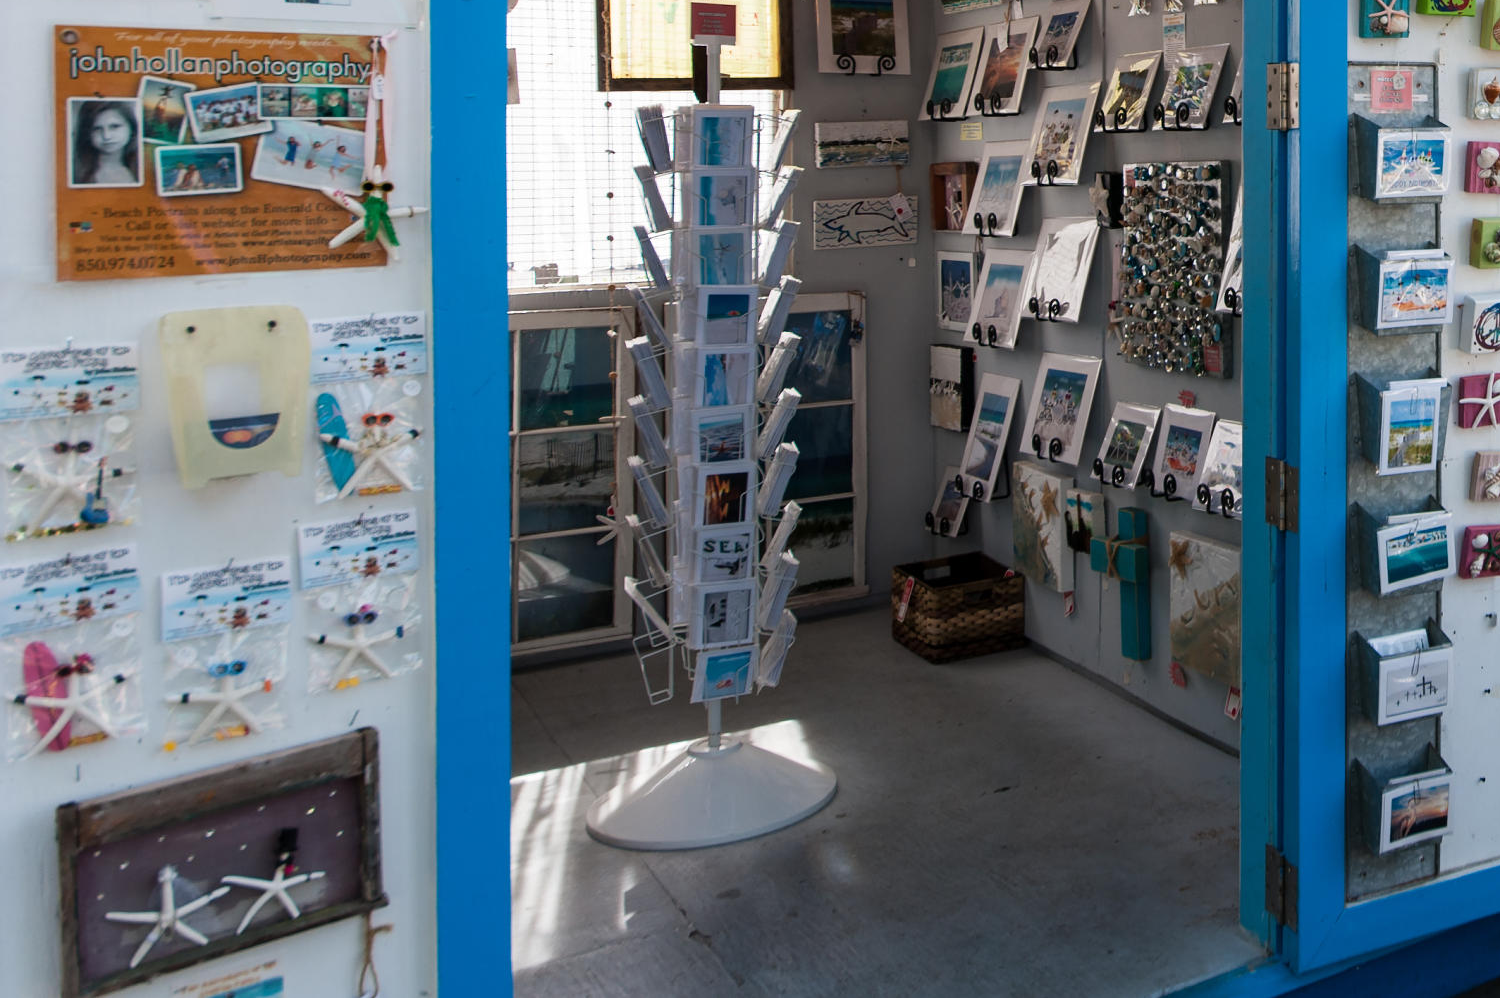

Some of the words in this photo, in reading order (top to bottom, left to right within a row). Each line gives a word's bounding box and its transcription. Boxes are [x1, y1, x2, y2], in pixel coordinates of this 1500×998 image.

[212, 34, 297, 49] photography
[103, 207, 145, 218] Beach
[147, 206, 200, 218] Portraits
[203, 205, 237, 218] along
[240, 204, 259, 214] the
[263, 203, 312, 214] Emerald
[126, 220, 149, 231] Call
[154, 222, 168, 231] or
[201, 219, 247, 229] website
[250, 217, 270, 227] for
[272, 218, 301, 227] more
[304, 215, 329, 226] info
[75, 256, 176, 271] 850.974.0724
